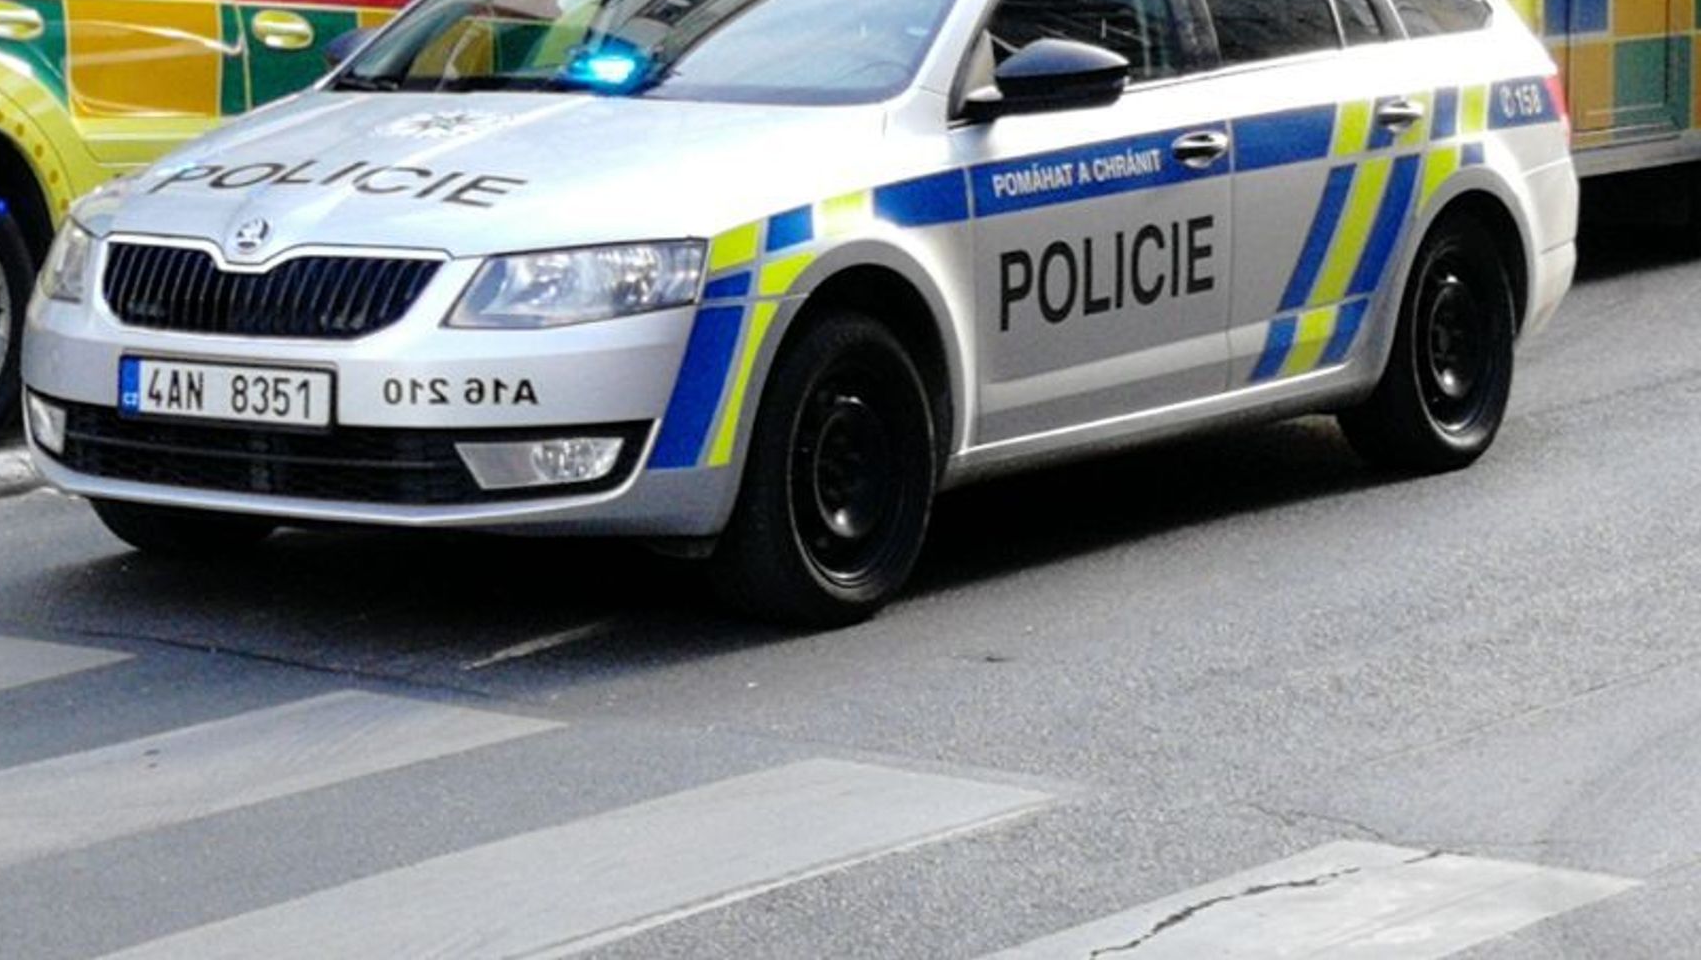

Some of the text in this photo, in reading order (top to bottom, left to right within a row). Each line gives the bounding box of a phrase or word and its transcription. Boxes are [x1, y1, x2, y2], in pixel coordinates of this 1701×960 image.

[1514, 84, 1542, 117] 158
[147, 160, 528, 209] POLICIE
[992, 147, 1162, 198] POMÁHAT A CHRÁNIT
[1000, 214, 1214, 332] POLICIE
[148, 368, 312, 420] 4AN 8351
